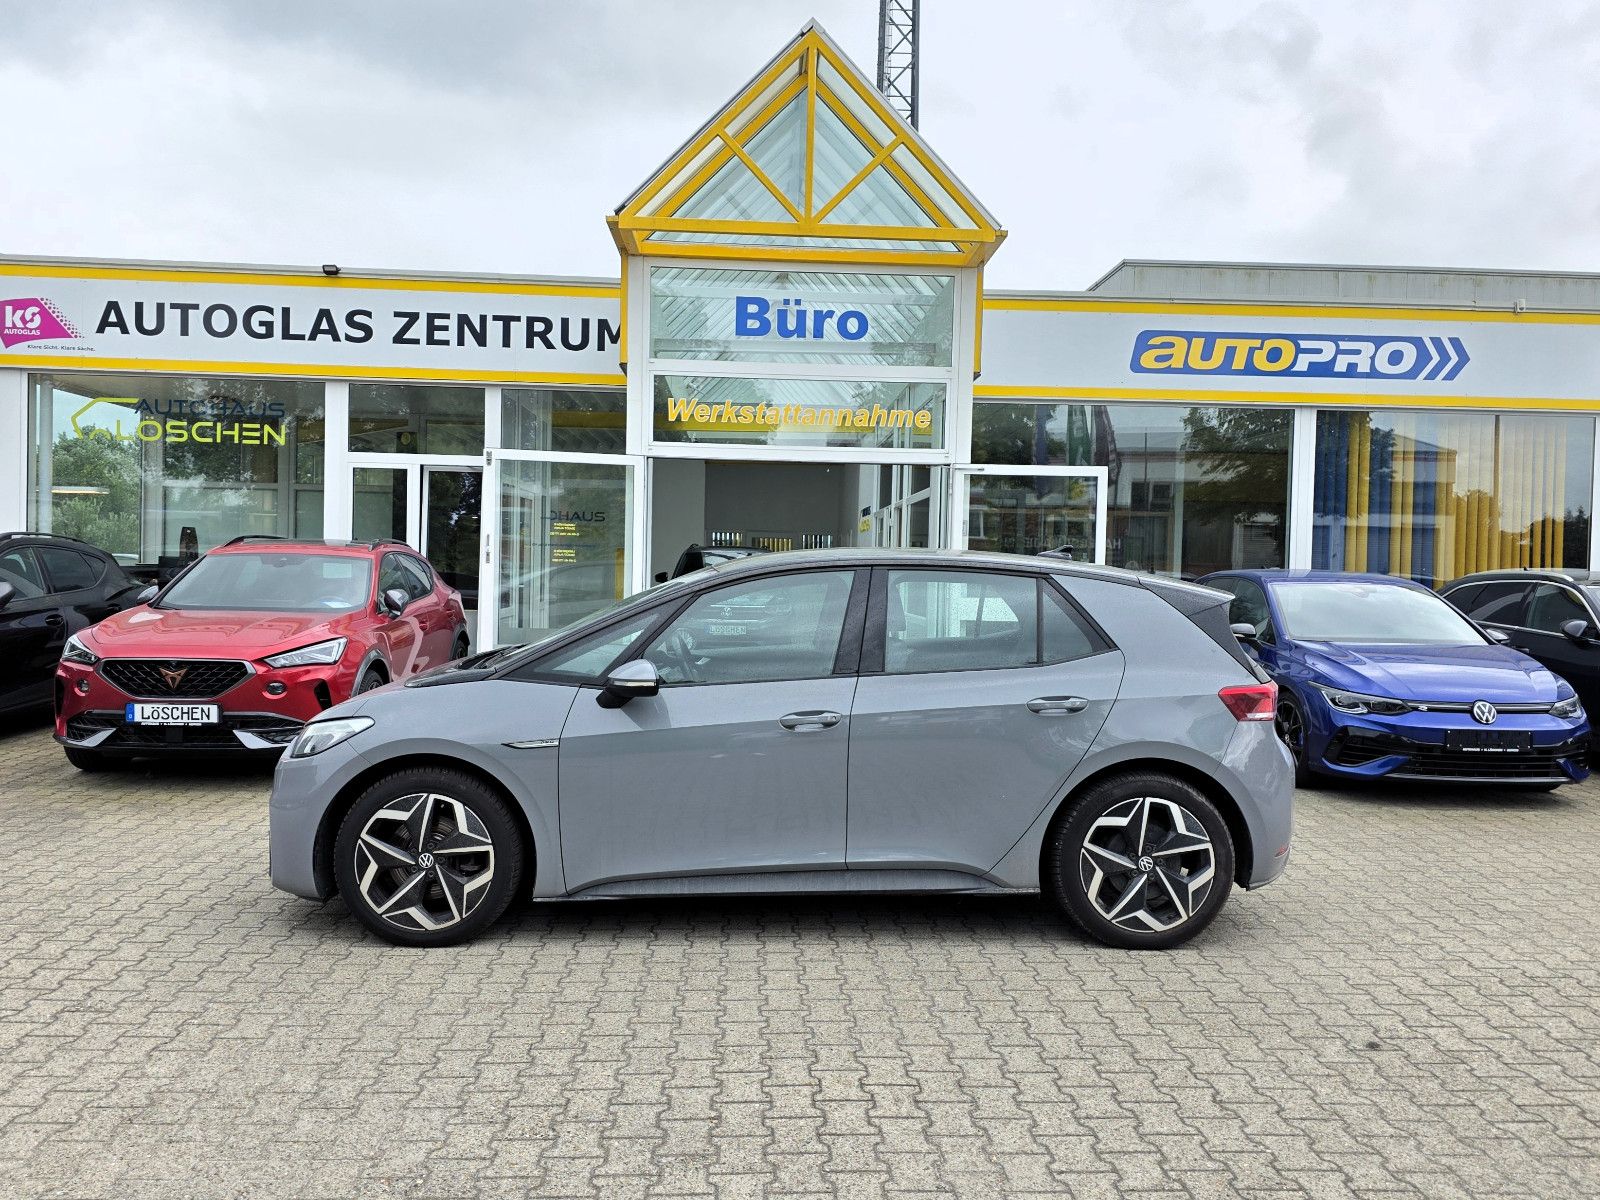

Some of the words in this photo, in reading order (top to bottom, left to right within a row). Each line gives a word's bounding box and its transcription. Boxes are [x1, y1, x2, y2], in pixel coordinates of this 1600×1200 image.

[4, 328, 41, 336] AUTOGLAS
[96, 300, 373, 344] AUTOGLAS
[735, 296, 869, 340] Büro
[135, 398, 285, 418] AUTOHAUS
[667, 397, 932, 428] Werkstattannahme
[116, 415, 286, 446] LÖSCHEN
